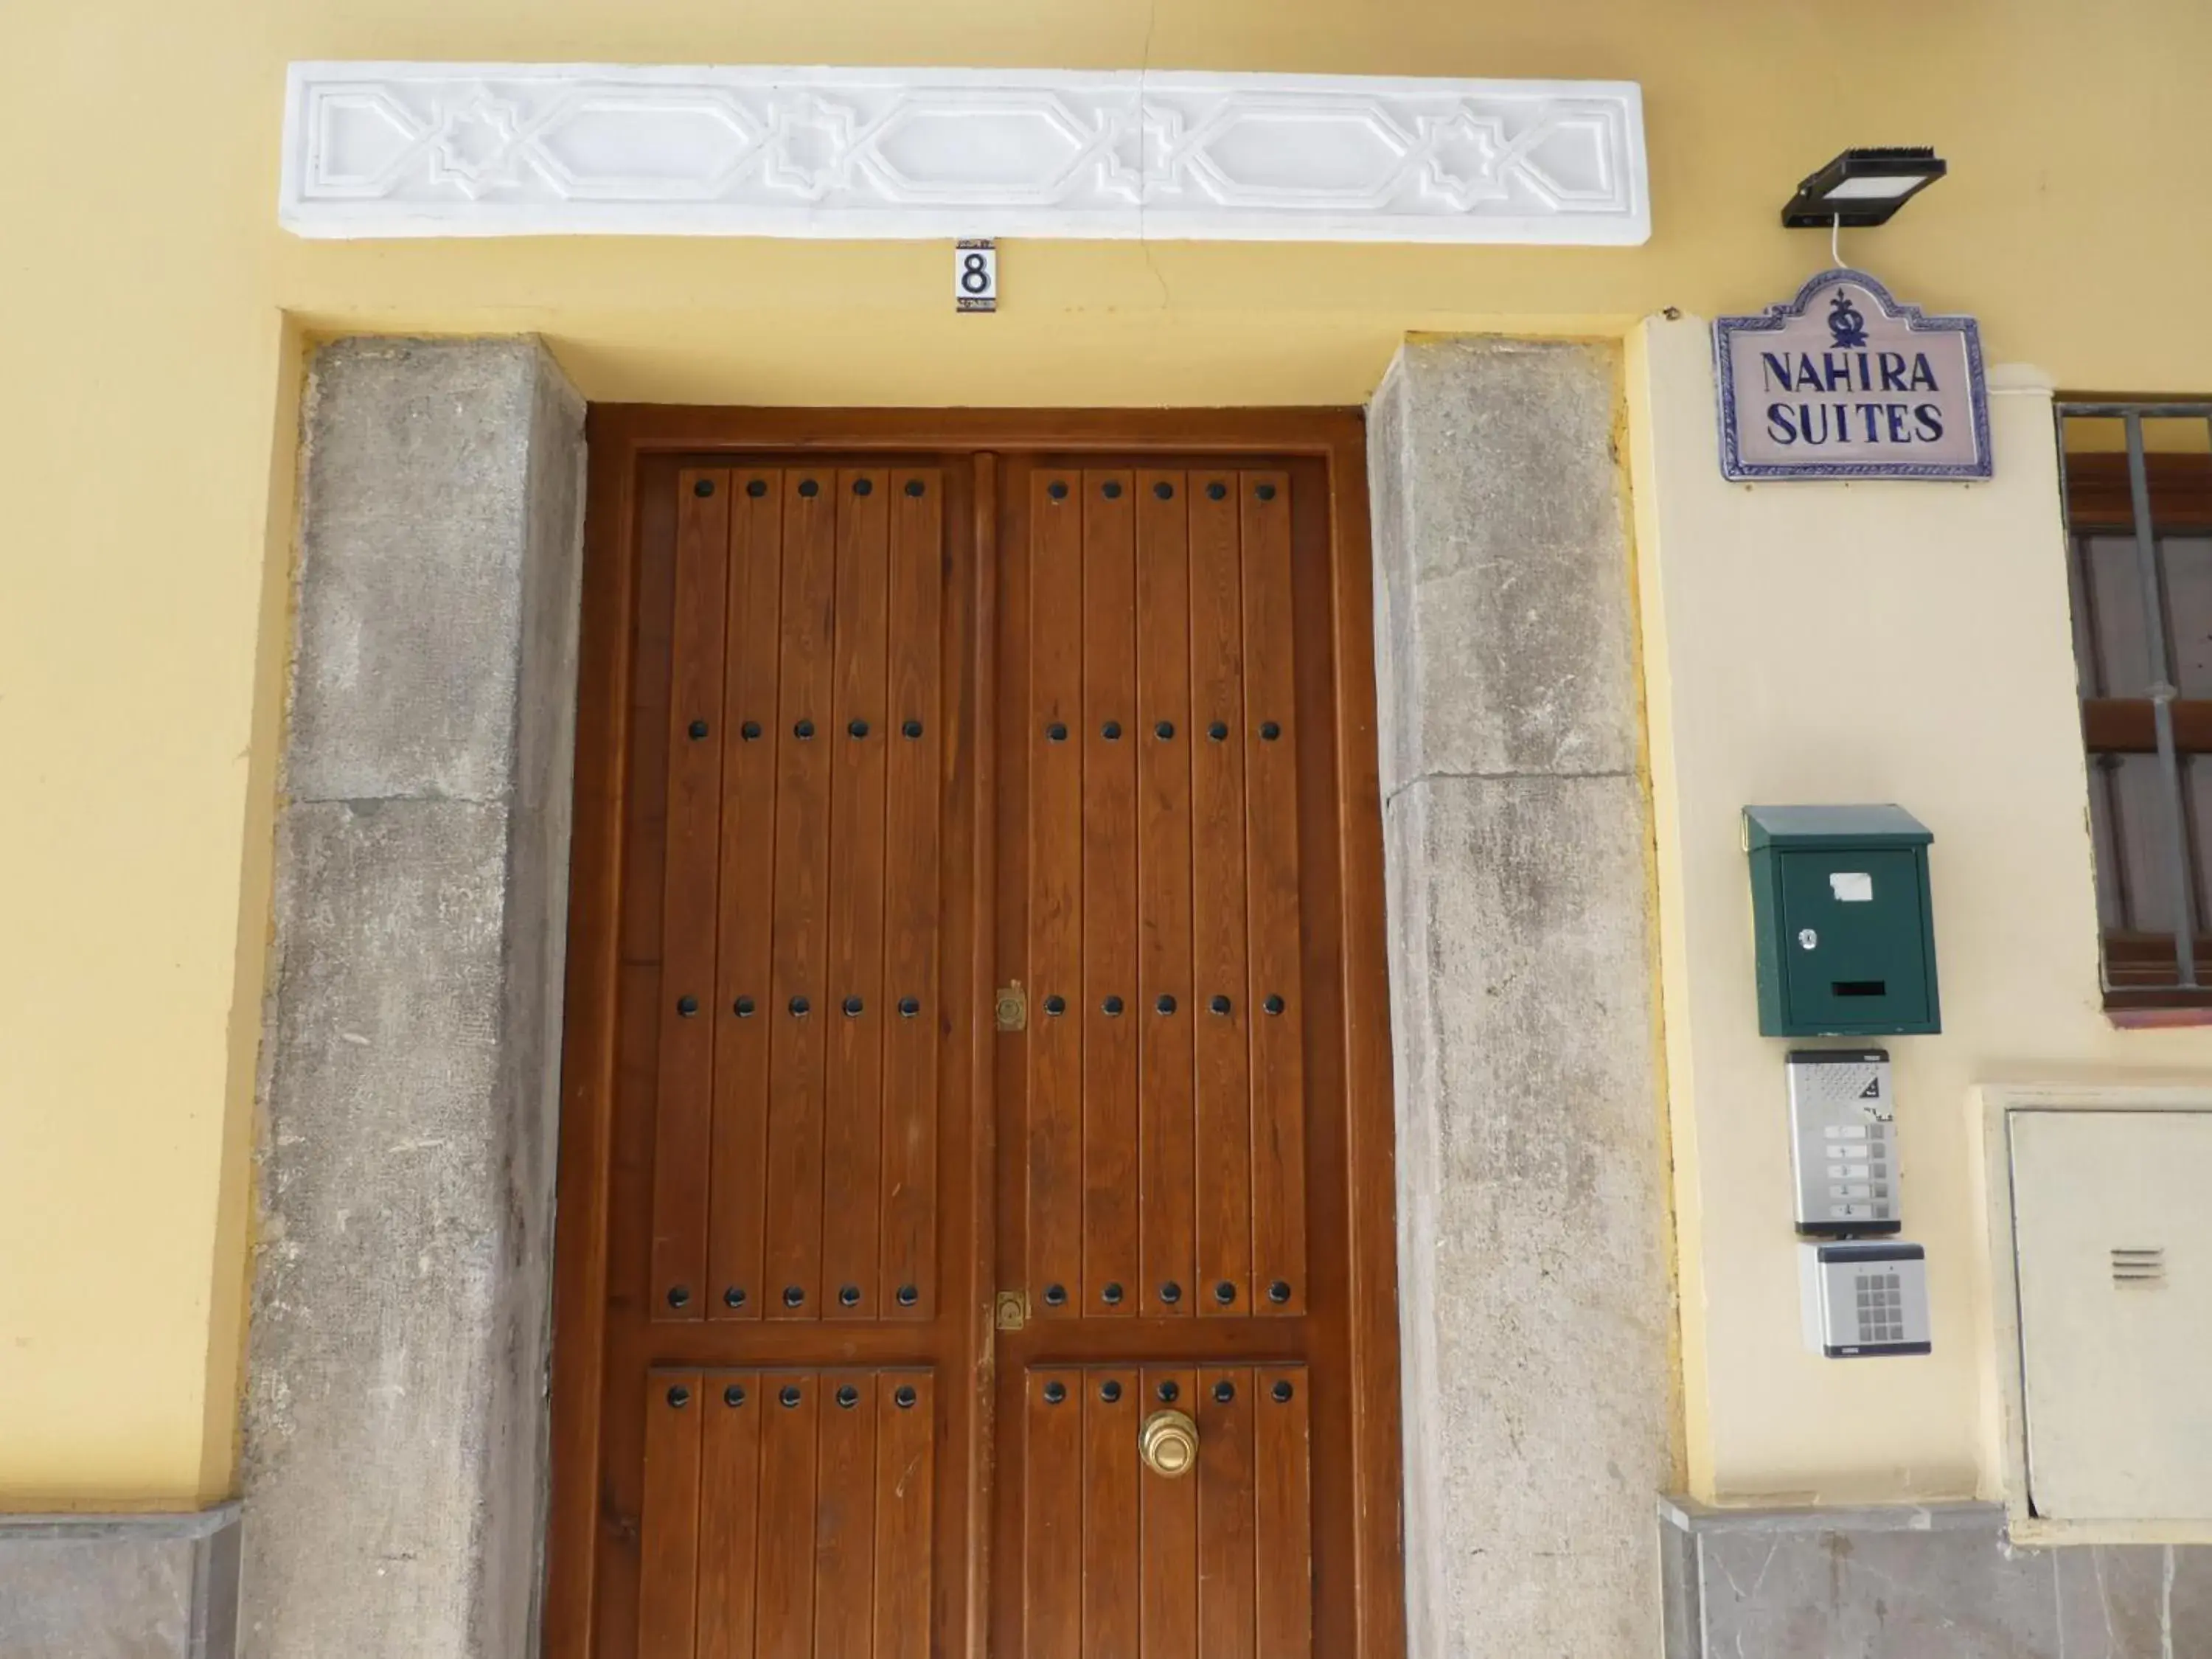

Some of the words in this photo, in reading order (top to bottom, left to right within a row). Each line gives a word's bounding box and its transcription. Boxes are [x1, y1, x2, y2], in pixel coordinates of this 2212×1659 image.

[961, 253, 989, 293] 8
[1760, 351, 1940, 393] NAHIRA
[1766, 403, 1944, 445] SUITES
